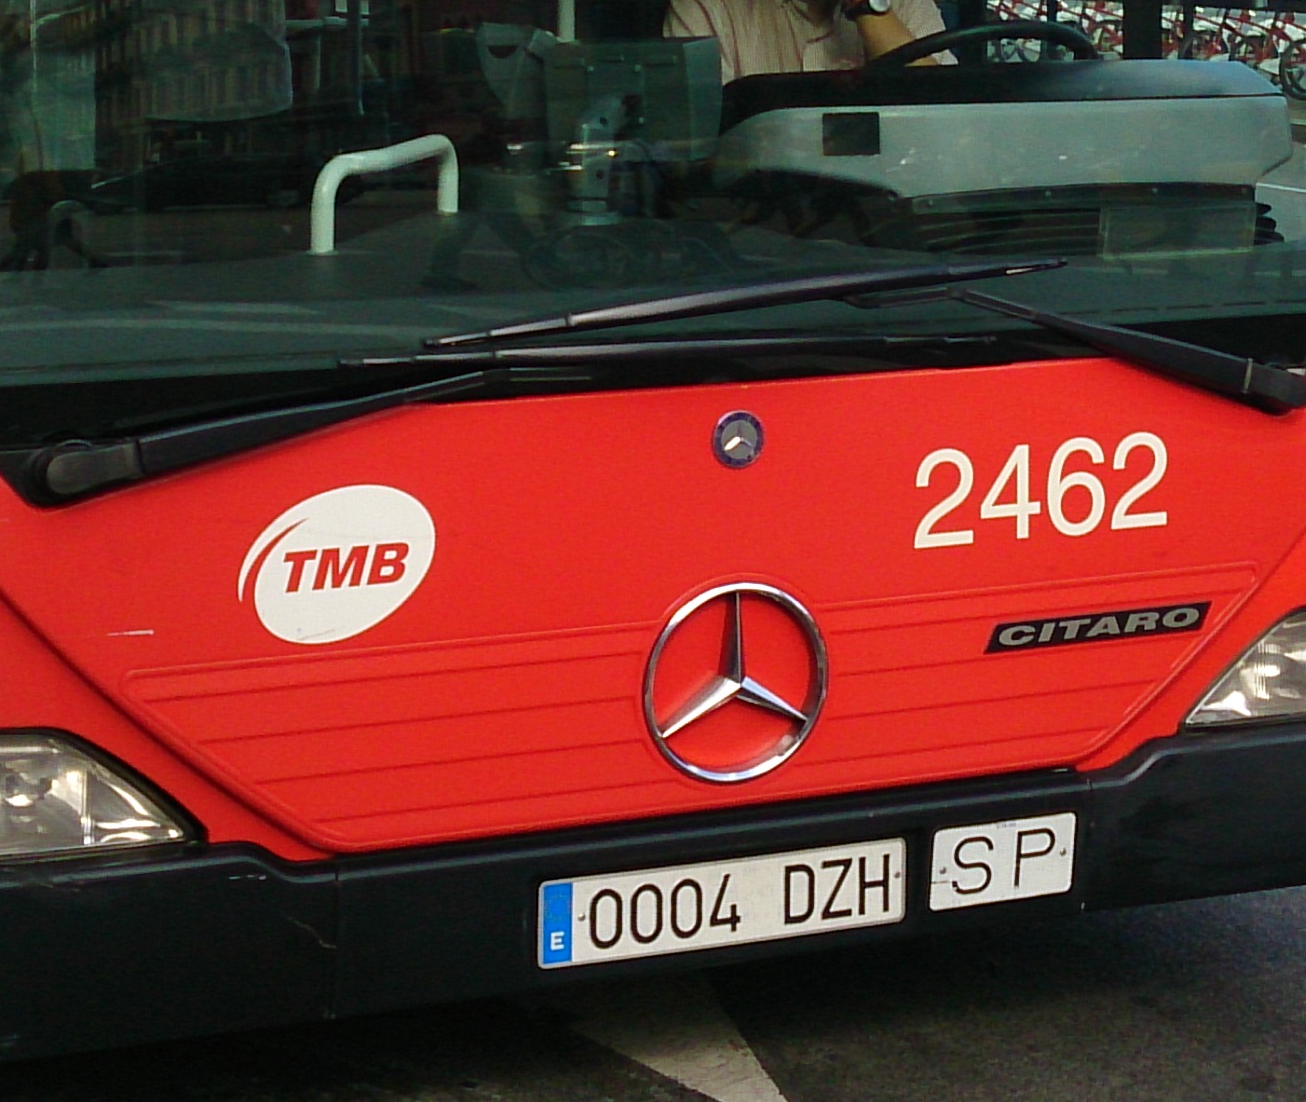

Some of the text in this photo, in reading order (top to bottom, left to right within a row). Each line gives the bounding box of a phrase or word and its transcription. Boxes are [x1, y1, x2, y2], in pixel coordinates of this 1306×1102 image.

[914, 431, 1168, 549] 2462
[283, 542, 409, 593] TMB
[998, 607, 1200, 646] CITARO
[589, 854, 890, 950] 0004 DZH
[549, 931, 565, 951] E
